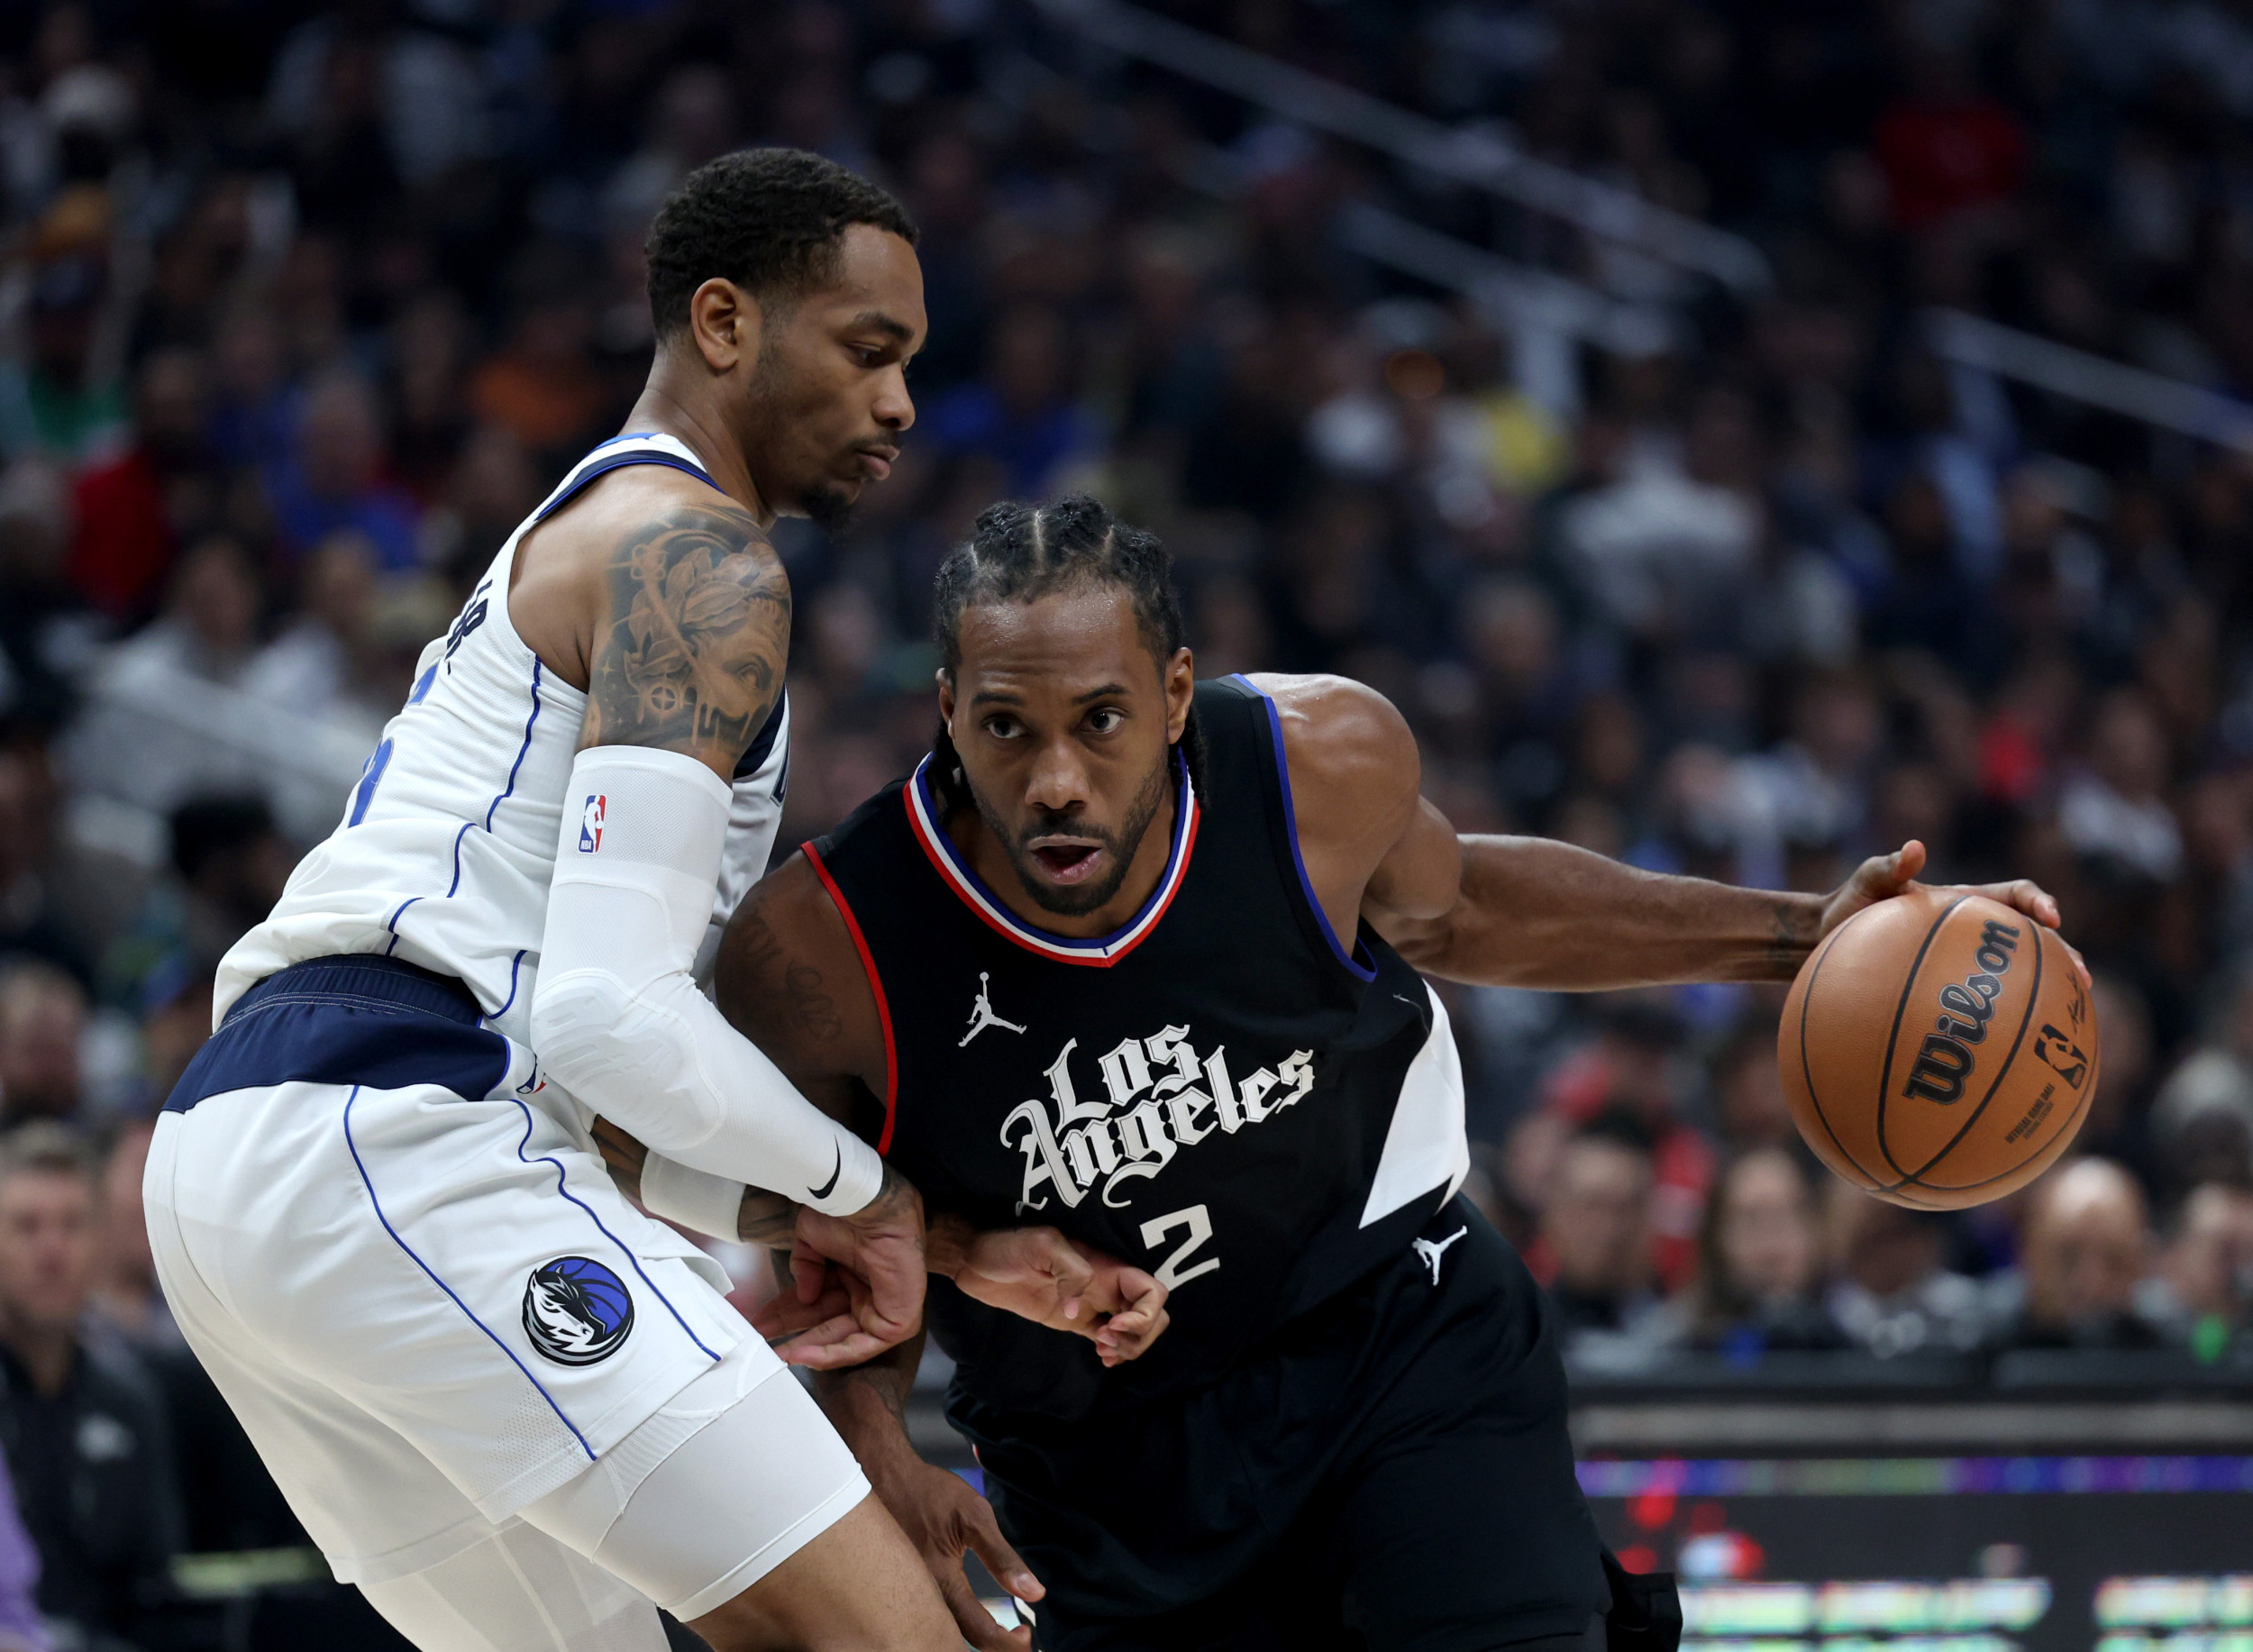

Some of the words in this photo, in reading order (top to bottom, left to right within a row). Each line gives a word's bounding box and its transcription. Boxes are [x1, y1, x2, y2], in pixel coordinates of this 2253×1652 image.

[579, 839, 592, 851] NBA
[1902, 919, 2020, 1105] Wilson
[999, 1045, 1316, 1217] Angeles
[1043, 1024, 1203, 1138] Los
[1139, 1204, 1220, 1291] 2
